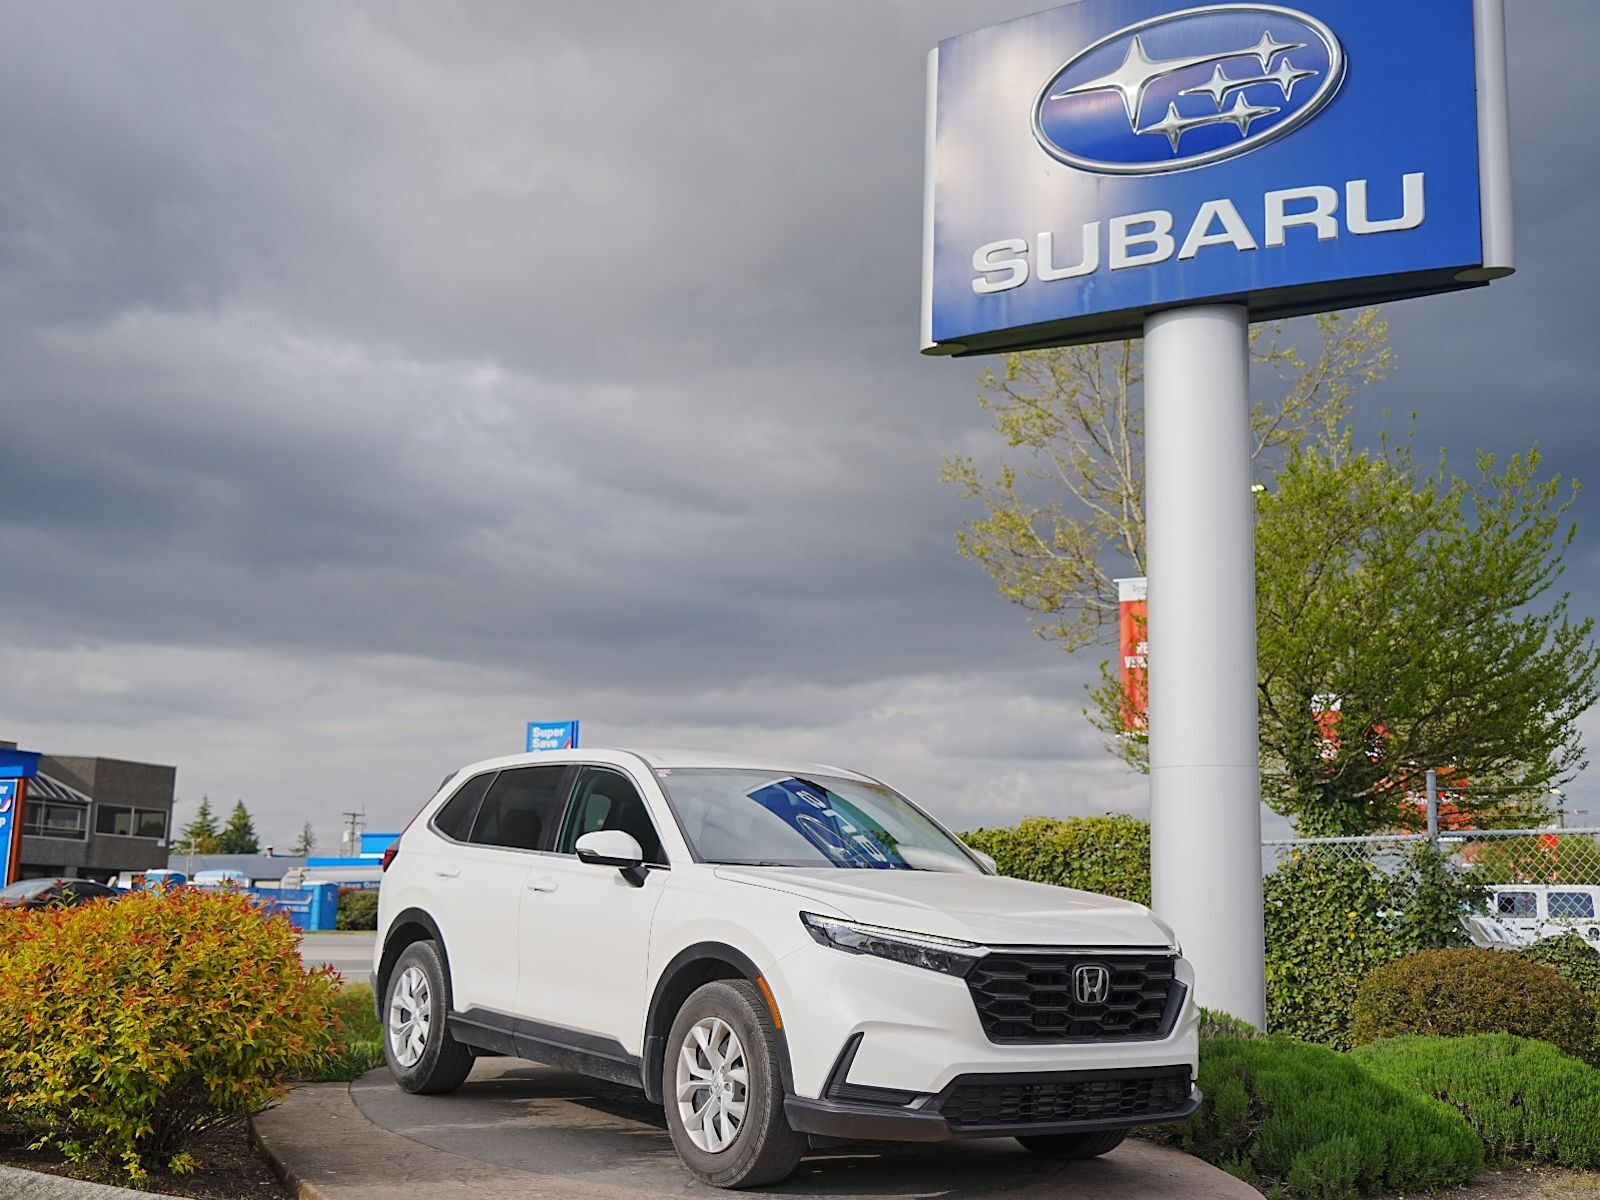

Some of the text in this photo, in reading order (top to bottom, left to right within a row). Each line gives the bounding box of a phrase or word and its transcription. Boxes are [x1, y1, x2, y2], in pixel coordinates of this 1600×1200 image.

[971, 171, 1425, 294] SUBARU
[532, 726, 565, 739] Super
[532, 738, 558, 749] Save
